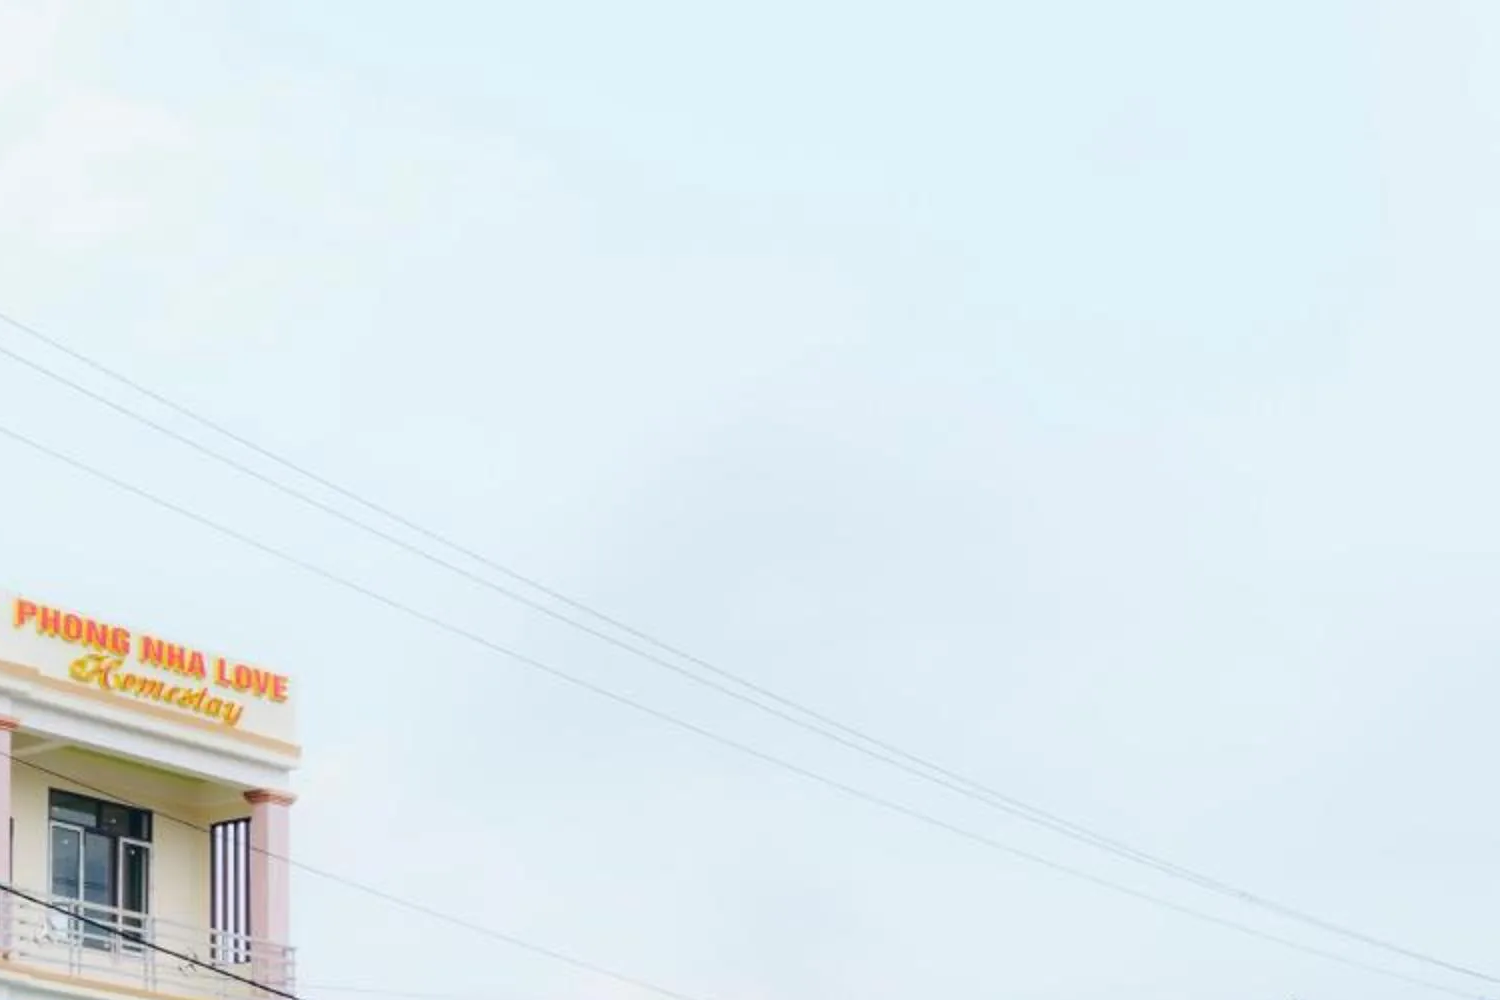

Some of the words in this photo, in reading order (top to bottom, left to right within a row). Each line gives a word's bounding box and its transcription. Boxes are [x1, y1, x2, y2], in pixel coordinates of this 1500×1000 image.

[13, 598, 131, 655] PHONG
[138, 633, 207, 680] NHA
[214, 655, 289, 704] LOVE
[68, 651, 244, 726] Homestay
